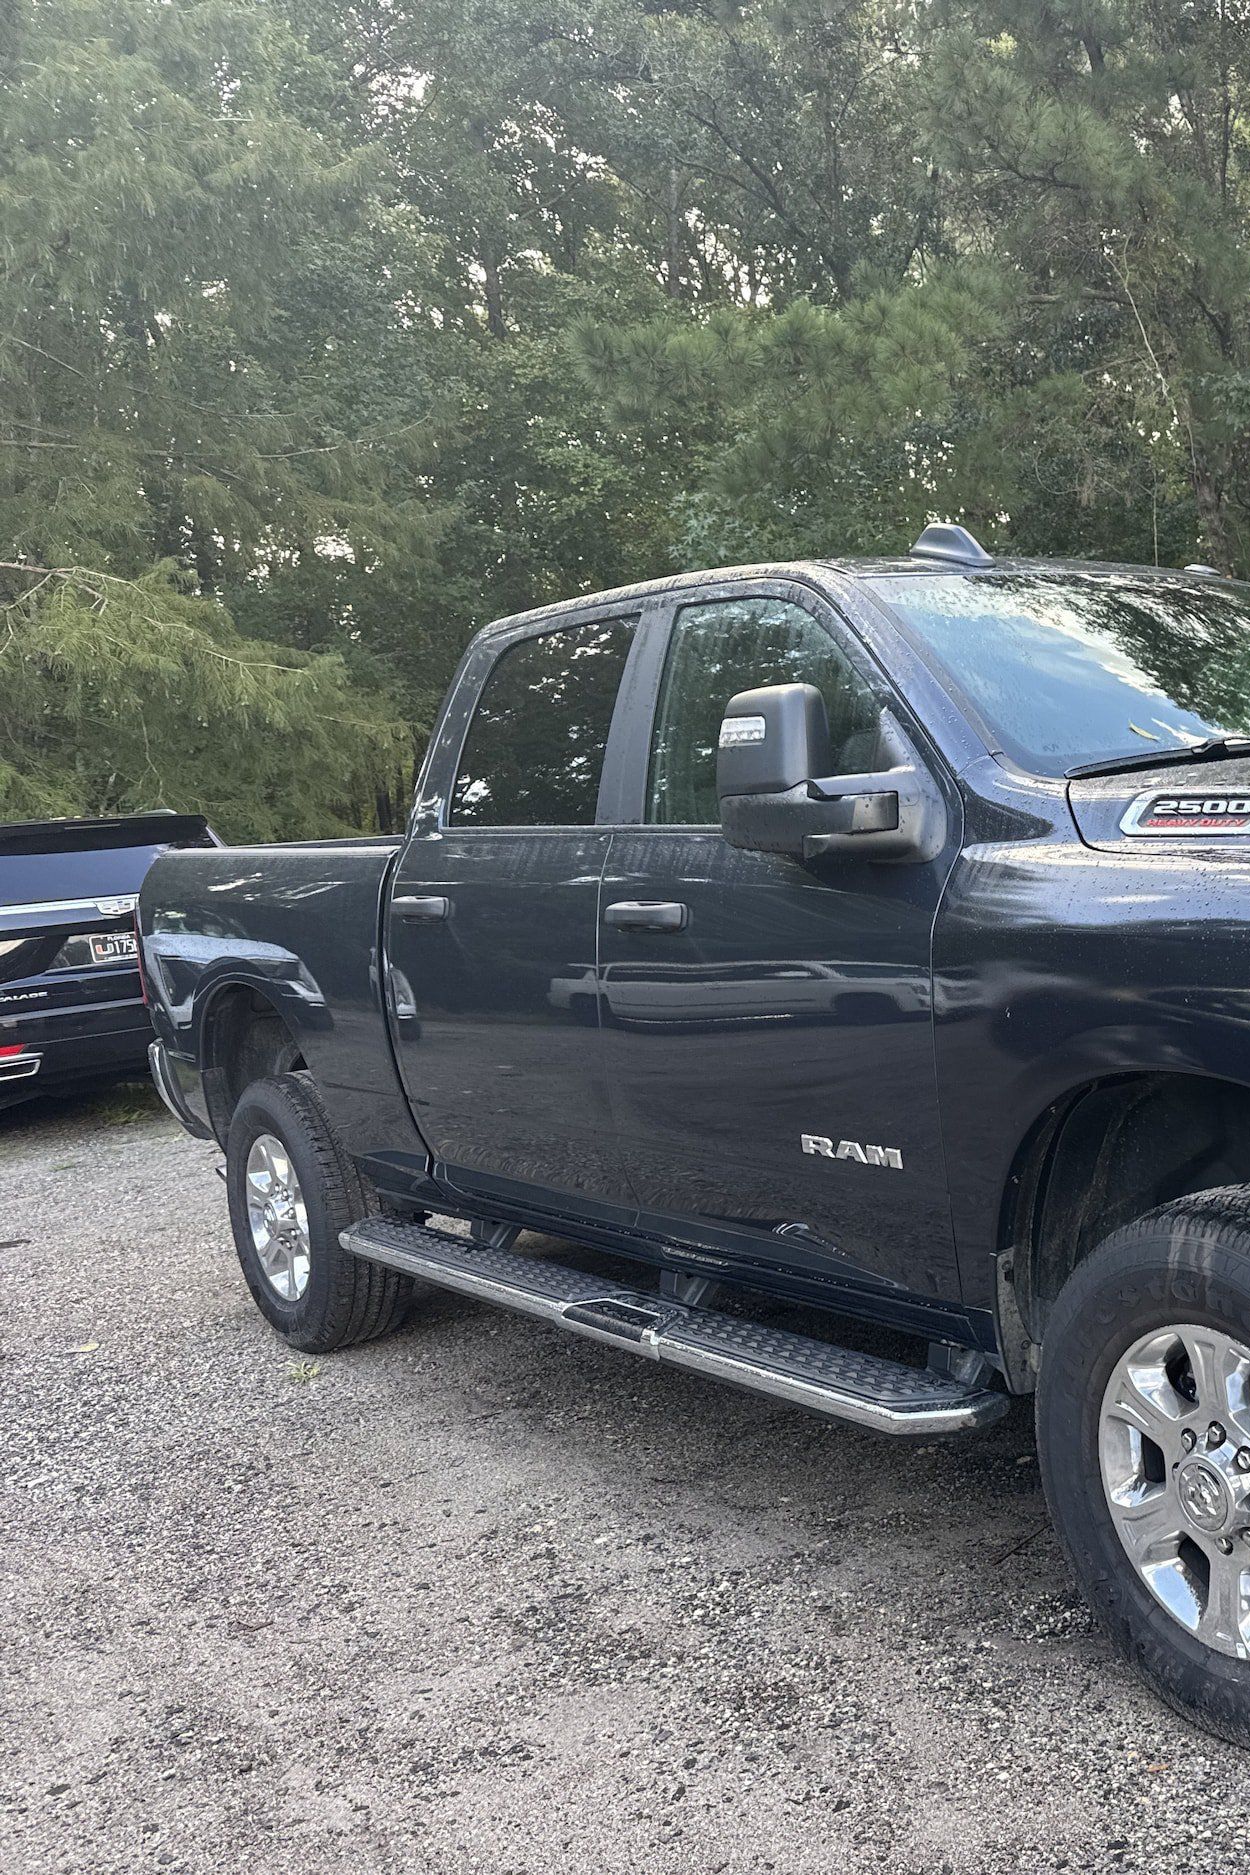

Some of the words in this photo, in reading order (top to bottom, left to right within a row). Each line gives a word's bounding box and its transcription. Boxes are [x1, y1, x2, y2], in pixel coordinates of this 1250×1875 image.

[1146, 818, 1198, 827] HEAVY
[1200, 818, 1246, 827] DUTY
[801, 1133, 904, 1170] RAM
